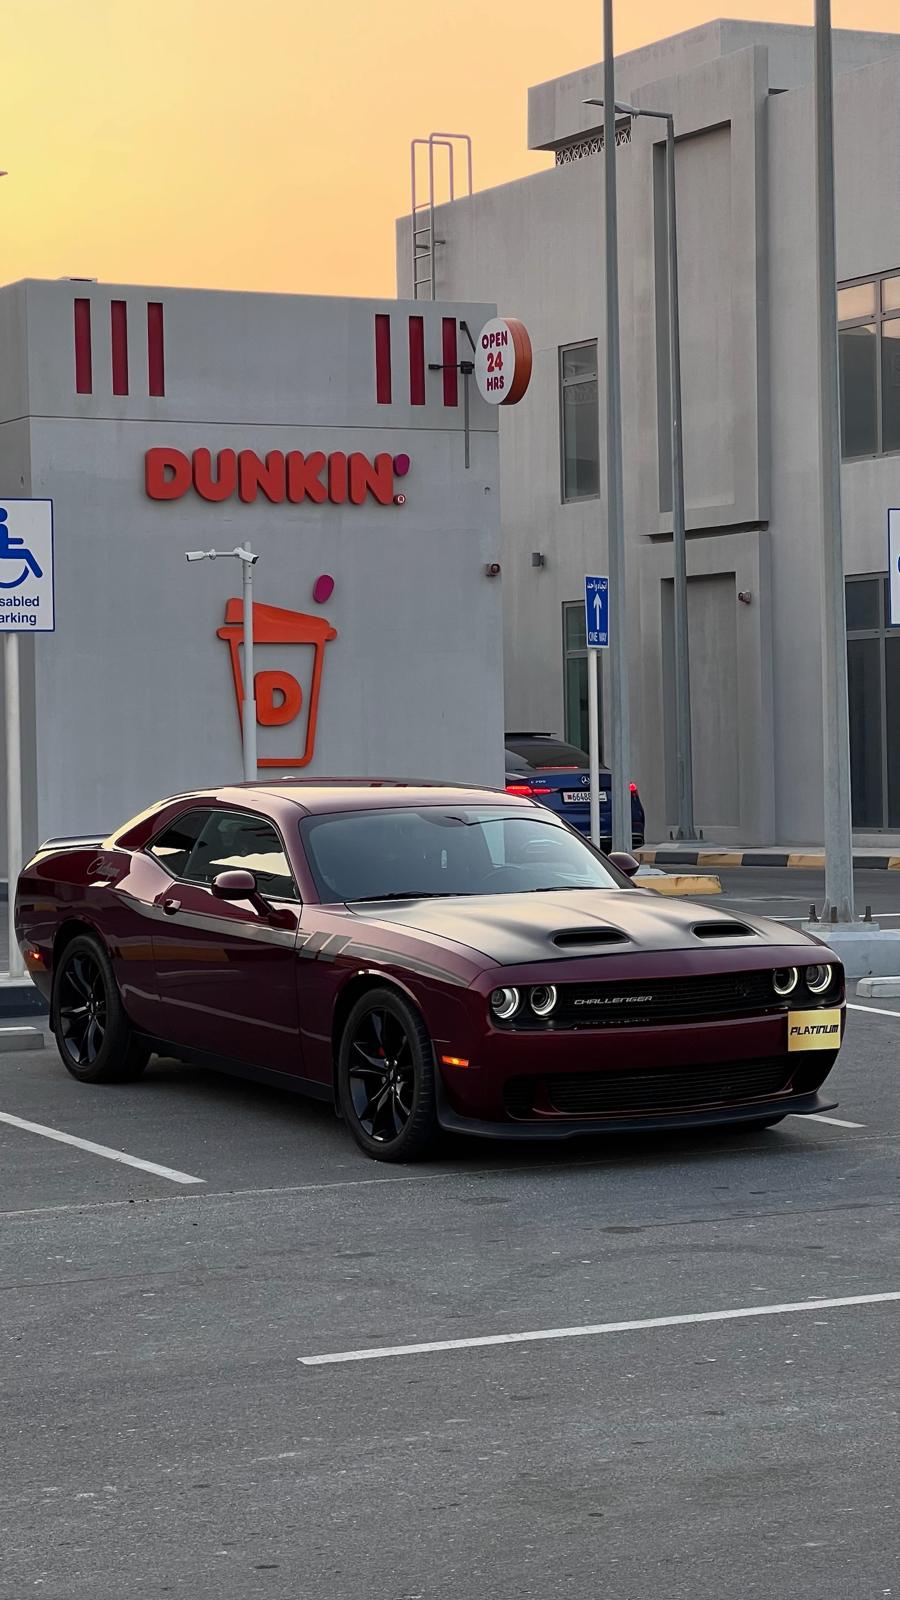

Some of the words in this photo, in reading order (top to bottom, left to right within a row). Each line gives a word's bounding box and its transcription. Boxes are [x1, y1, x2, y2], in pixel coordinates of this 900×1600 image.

[481, 330, 508, 349] OPEN
[487, 351, 503, 372] 24
[486, 376, 504, 391] HRS
[588, 631, 598, 642] ONE
[599, 632, 608, 642] WAY
[254, 671, 303, 727] D
[573, 995, 653, 1006] CHALLENGER
[790, 1024, 839, 1036] PLATINUM
